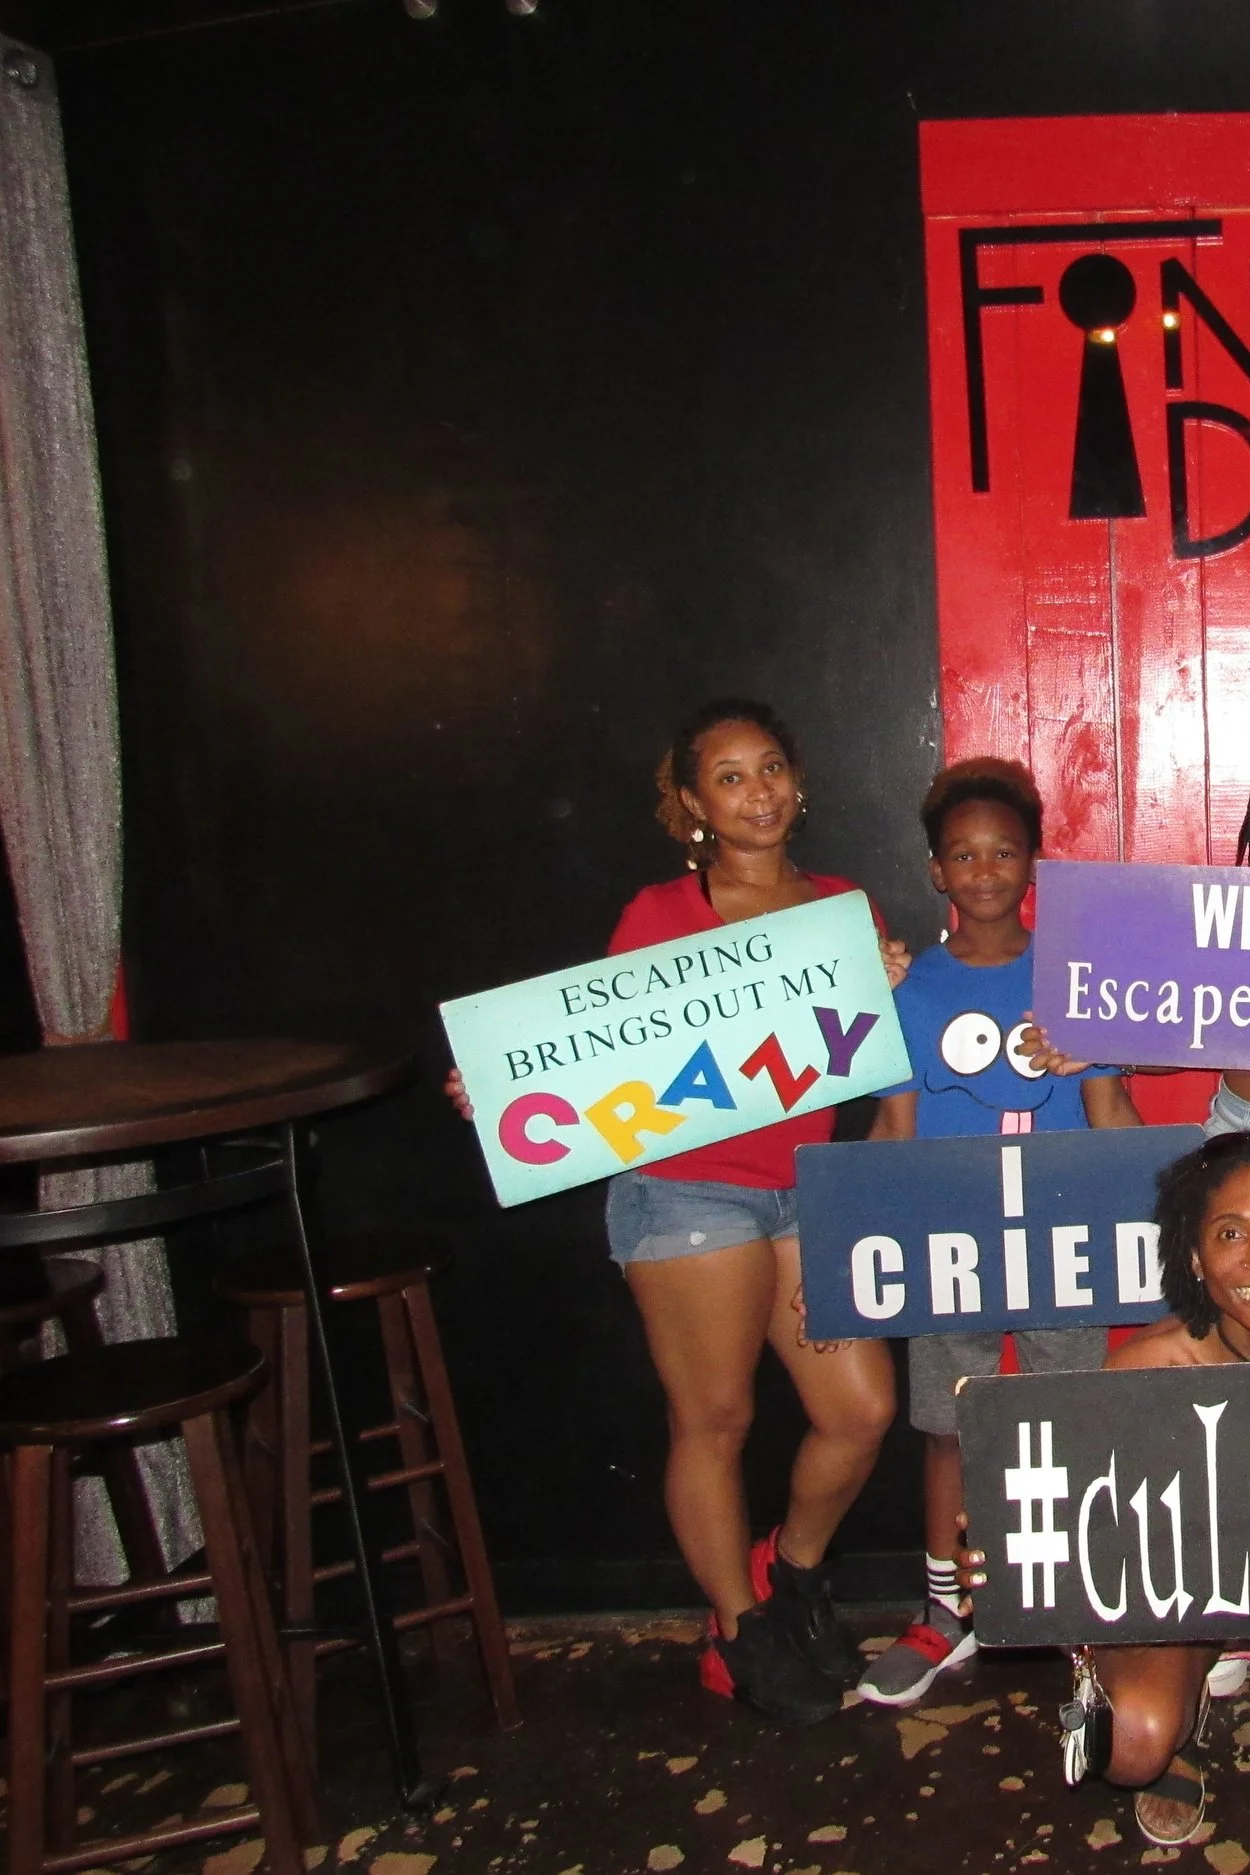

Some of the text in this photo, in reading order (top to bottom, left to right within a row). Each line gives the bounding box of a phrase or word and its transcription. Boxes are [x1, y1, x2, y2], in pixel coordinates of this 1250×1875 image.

[503, 958, 841, 1081] BRINGS OUT MY
[558, 933, 774, 1017] ESCAPING
[498, 1005, 881, 1165] CRAZY
[1001, 1146, 1025, 1217] I
[851, 1222, 1164, 1320] CRIED
